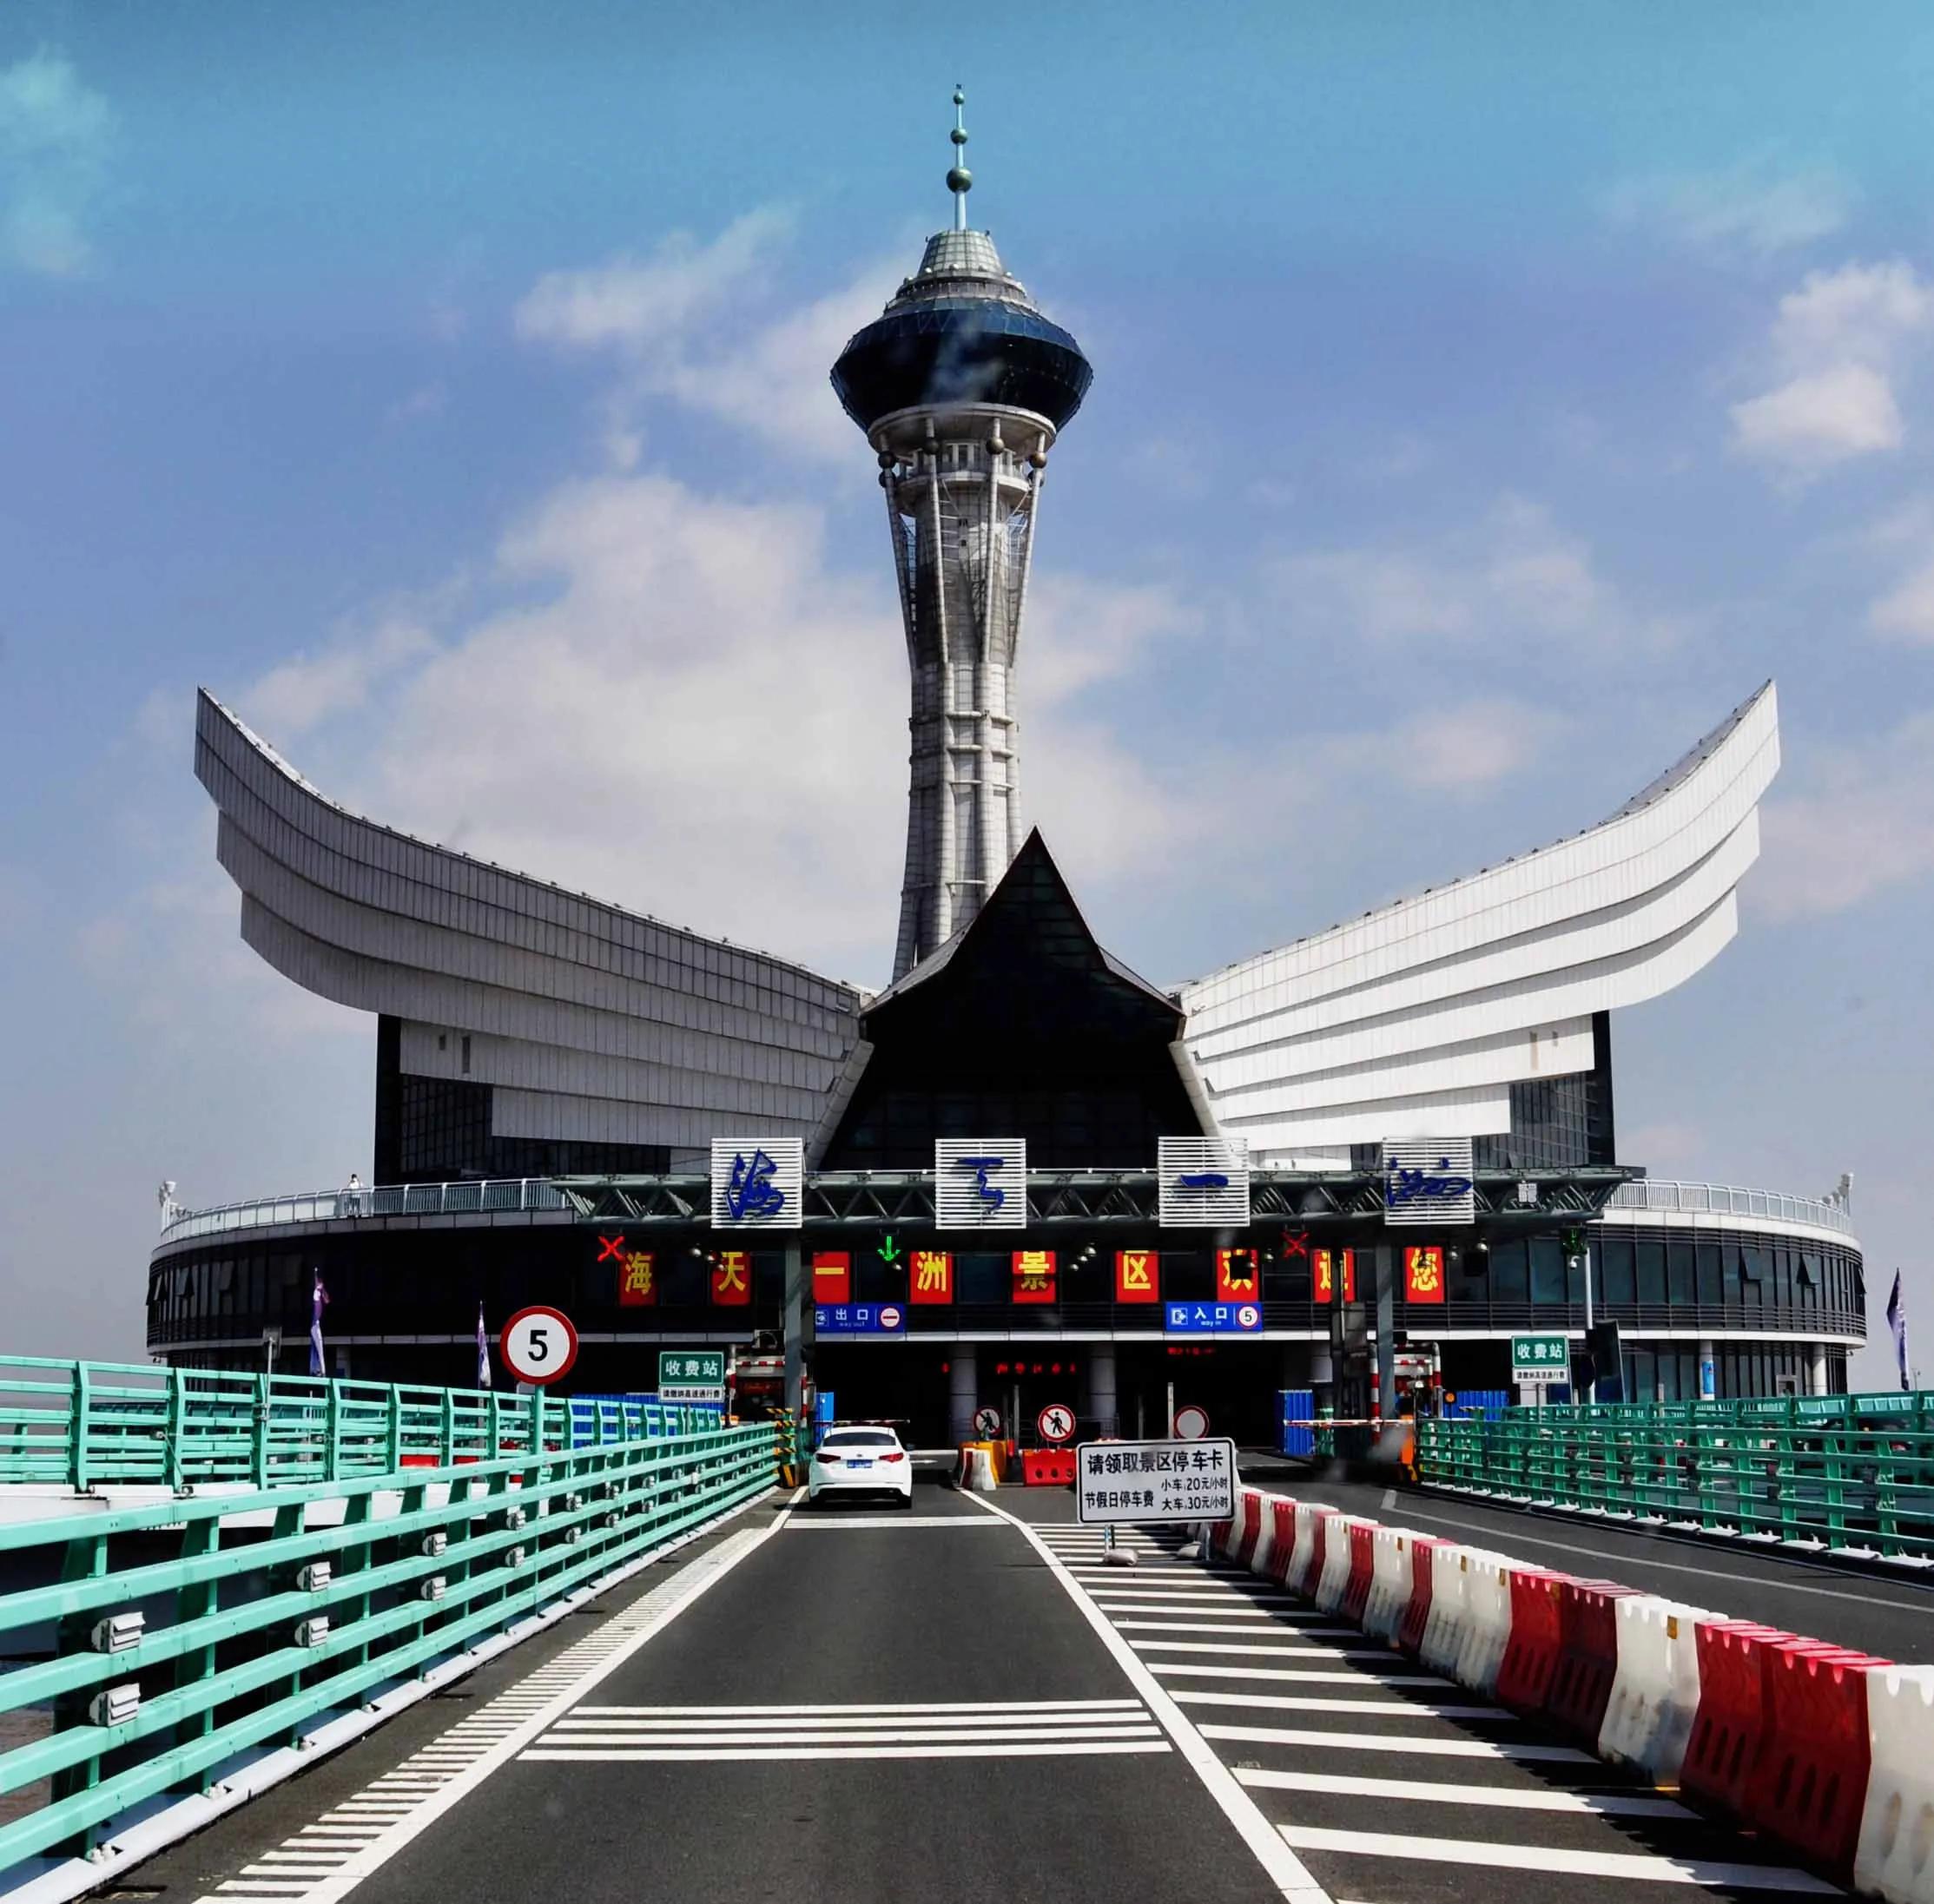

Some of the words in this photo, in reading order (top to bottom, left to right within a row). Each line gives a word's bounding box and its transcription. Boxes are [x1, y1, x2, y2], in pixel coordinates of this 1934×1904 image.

[835, 1308, 868, 1321] 出口
[1194, 1307, 1227, 1320] 入口
[1244, 1311, 1252, 1321] 5
[528, 1329, 548, 1361] 5
[1517, 1343, 1562, 1360] 收费站
[665, 1360, 718, 1376] 收费站
[1087, 1449, 1223, 1475] 请领取景区停车卡
[1085, 1491, 1154, 1509] 节假日停车费
